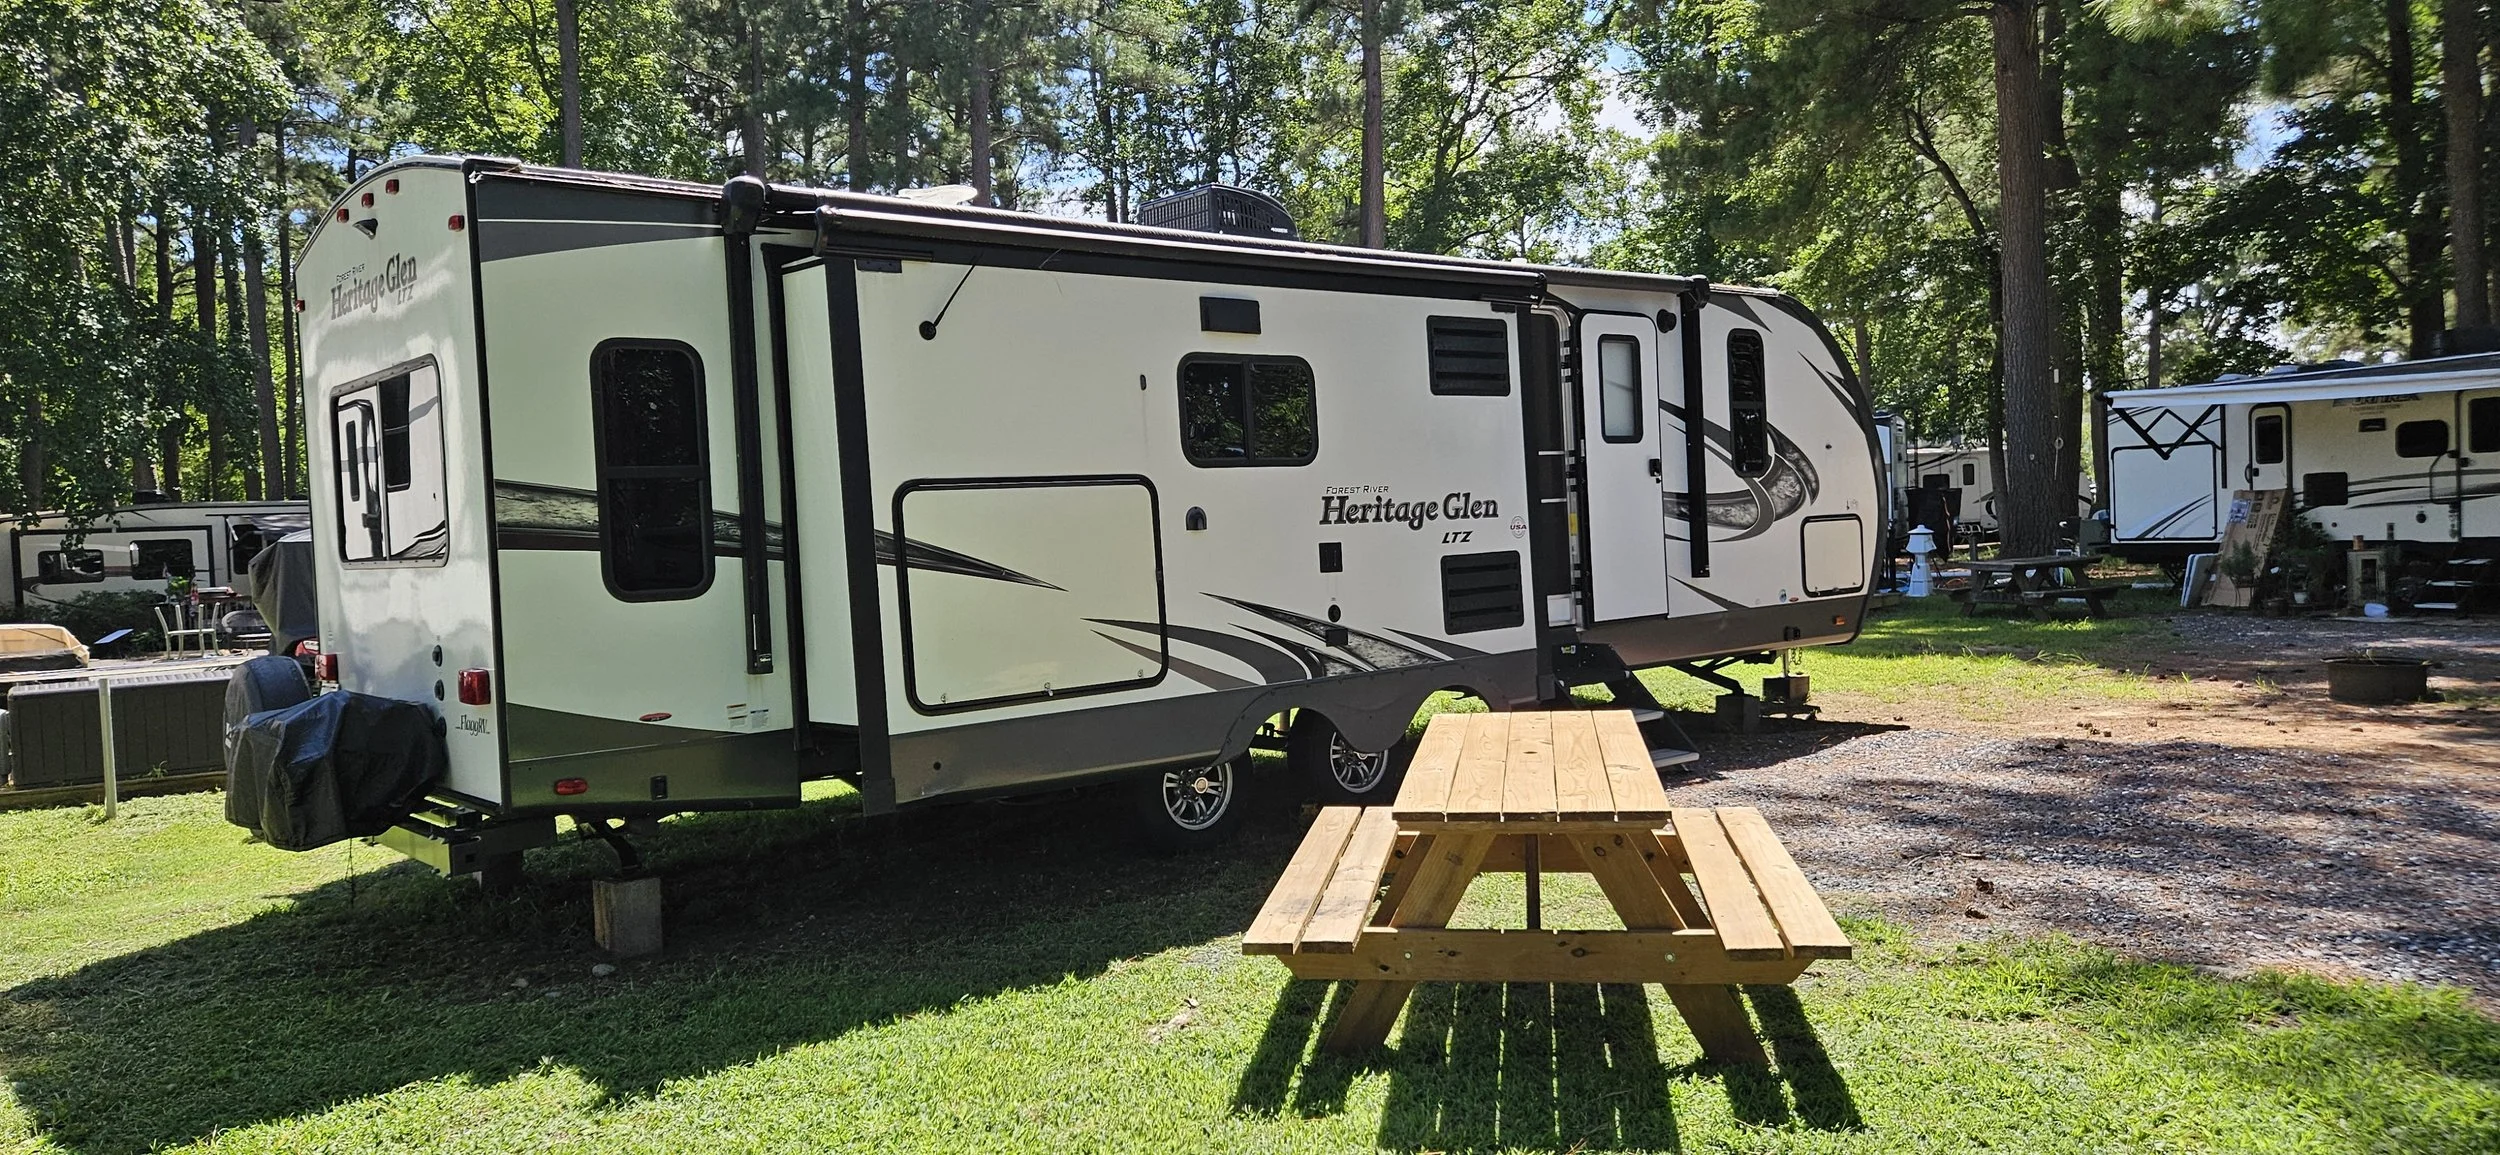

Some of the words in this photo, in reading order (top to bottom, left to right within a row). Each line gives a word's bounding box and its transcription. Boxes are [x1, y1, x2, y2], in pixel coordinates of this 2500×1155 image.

[331, 273, 385, 320] Heritage
[386, 252, 418, 293] Glen
[397, 283, 414, 305] LTZ
[1326, 486, 1361, 495] FOREST
[1363, 485, 1389, 493] RIVER
[1319, 495, 1439, 531] Heritage
[1442, 492, 1499, 520] Glen
[1441, 530, 1474, 544] LTZ
